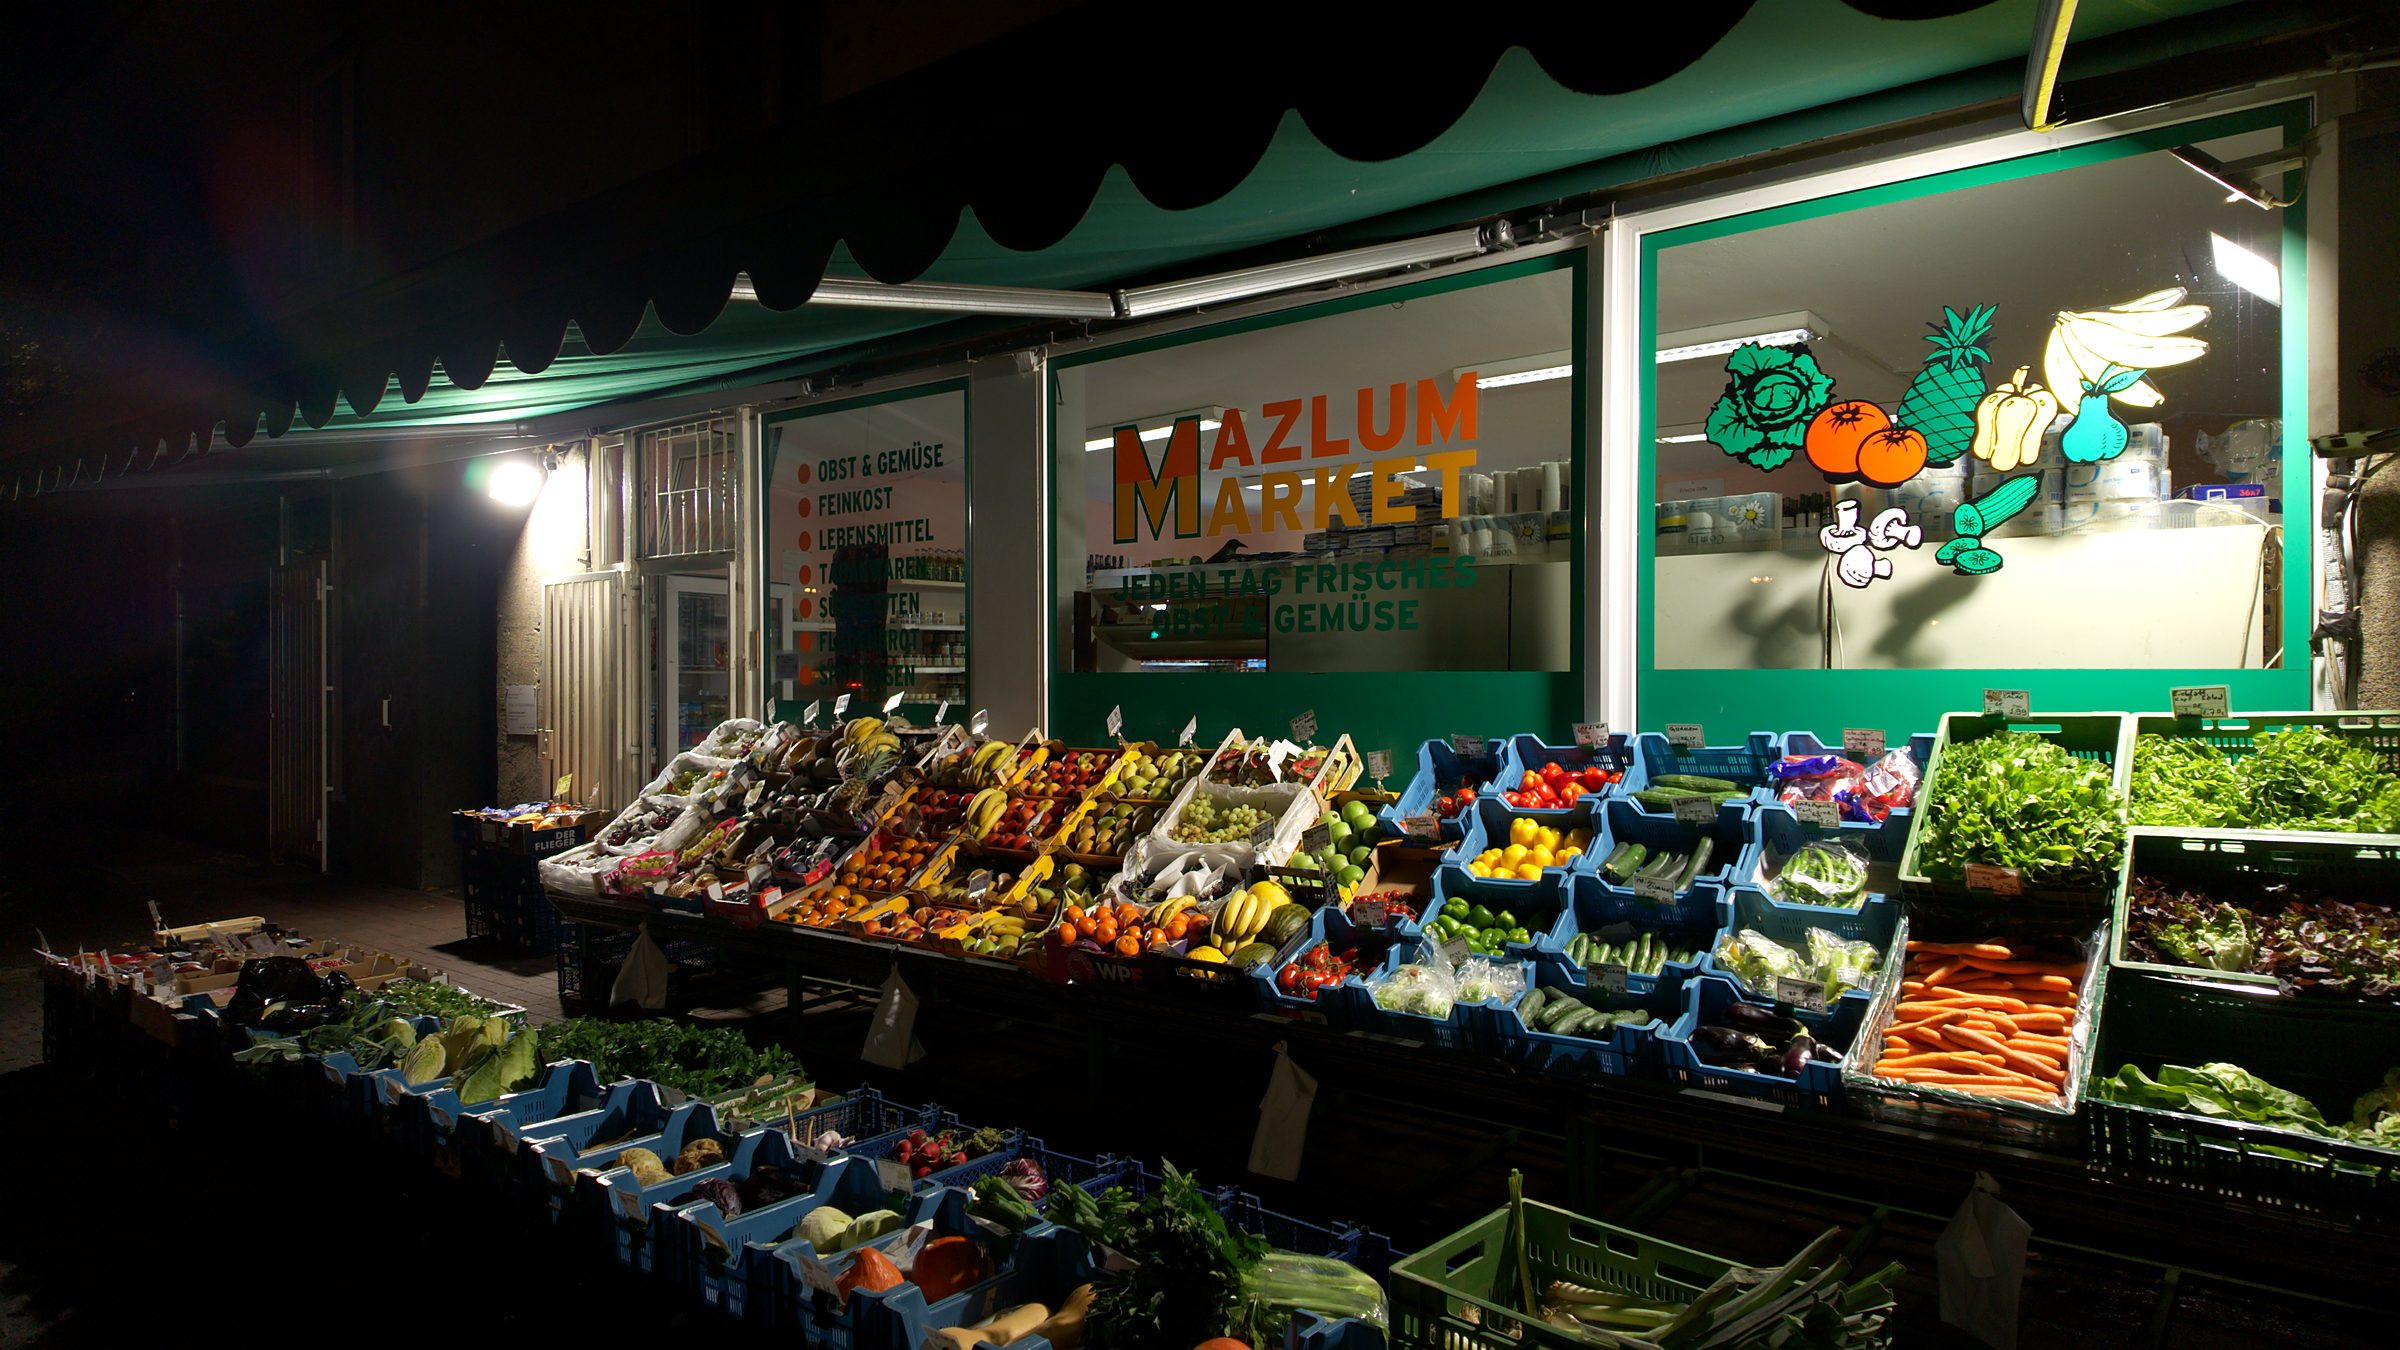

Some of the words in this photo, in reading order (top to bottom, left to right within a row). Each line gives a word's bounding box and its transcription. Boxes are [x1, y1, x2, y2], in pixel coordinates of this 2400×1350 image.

[818, 456, 857, 482] OBST
[862, 454, 872, 477] &
[878, 441, 944, 473] GEMÜSE
[1113, 371, 1478, 544] MAZLUM
[818, 486, 893, 517] FEINKOST
[819, 518, 934, 551] LEBENSMITTEL
[1114, 571, 1204, 602] JEDEN
[1218, 567, 1281, 597] TAG
[1296, 555, 1478, 595] FRISCHES
[1151, 607, 1230, 637] OBST
[1242, 607, 1263, 635] &
[1275, 593, 1420, 633] GEMÜSE
[534, 838, 576, 852] FLIEGER
[555, 829, 576, 840] DER
